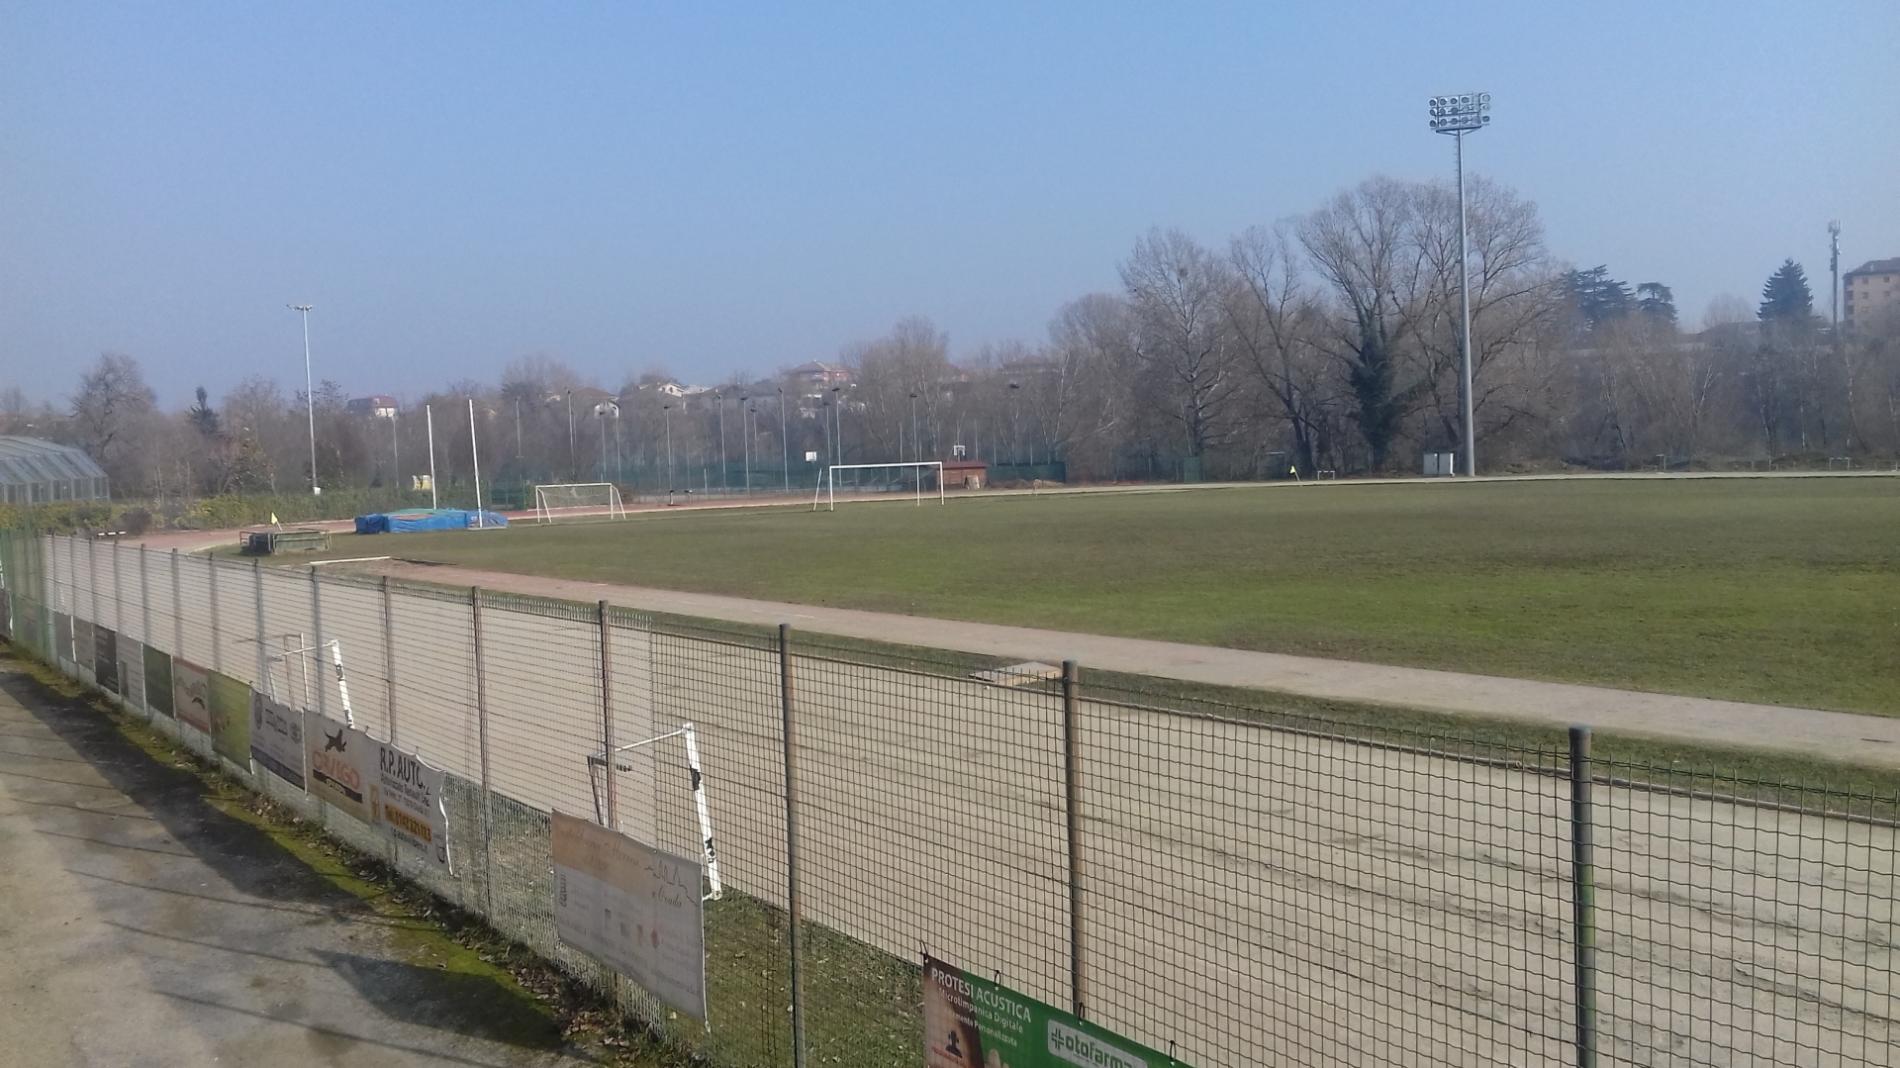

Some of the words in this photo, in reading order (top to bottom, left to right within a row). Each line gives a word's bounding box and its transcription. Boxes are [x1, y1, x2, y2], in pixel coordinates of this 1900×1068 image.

[931, 967, 974, 998] PROTESI
[976, 986, 1032, 1023] ACUSTICA
[993, 1011, 1024, 1034] Digitale
